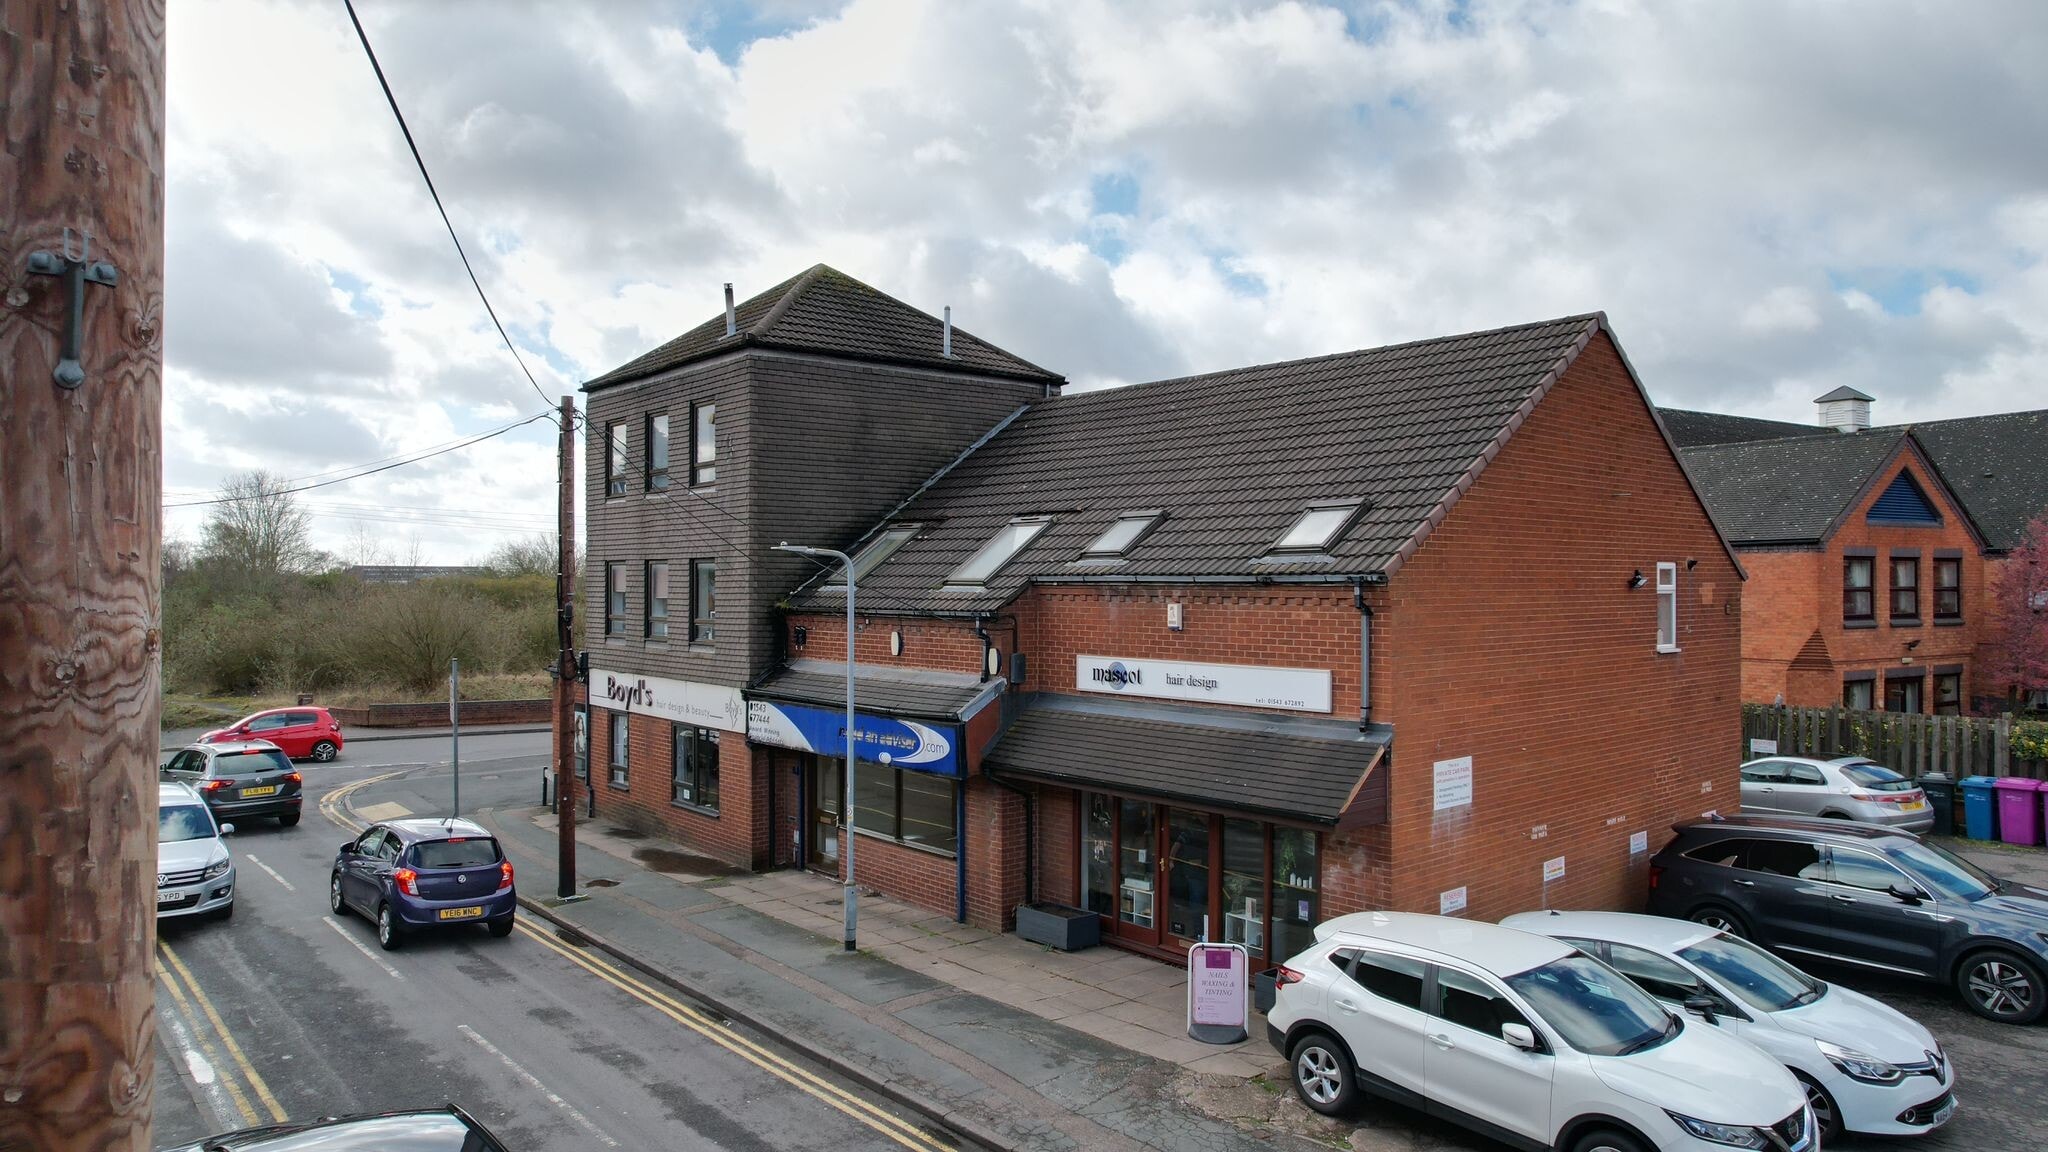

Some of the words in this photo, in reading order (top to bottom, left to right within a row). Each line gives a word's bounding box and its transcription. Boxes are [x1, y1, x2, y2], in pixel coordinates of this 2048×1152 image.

[1092, 666, 1143, 686] mascot
[1166, 673, 1185, 685] hair
[1186, 675, 1218, 691] design
[607, 674, 654, 711] Boyd's
[444, 908, 462, 917] YE16
